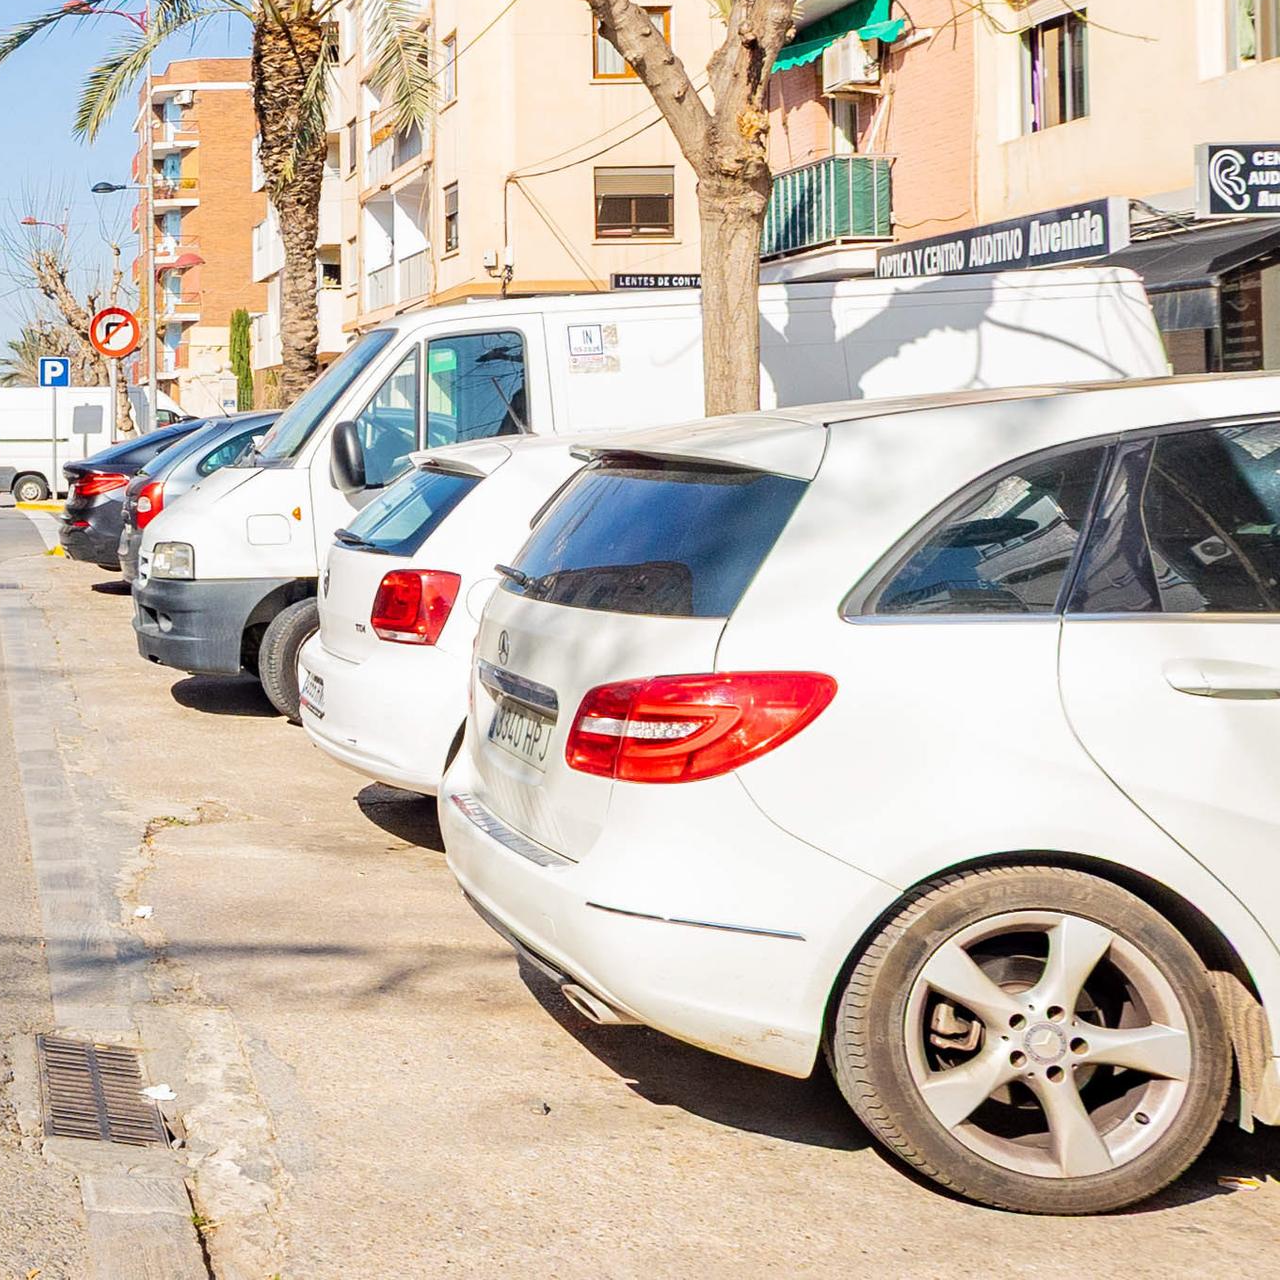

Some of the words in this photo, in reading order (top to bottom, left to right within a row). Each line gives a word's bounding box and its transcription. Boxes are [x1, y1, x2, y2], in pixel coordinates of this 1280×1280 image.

[924, 239, 964, 276] CENTRO
[968, 227, 1023, 269] AUDITIVO
[1029, 210, 1105, 257] Avenida
[619, 276, 655, 287] LENTES
[657, 276, 669, 287] DE
[44, 360, 65, 385] P
